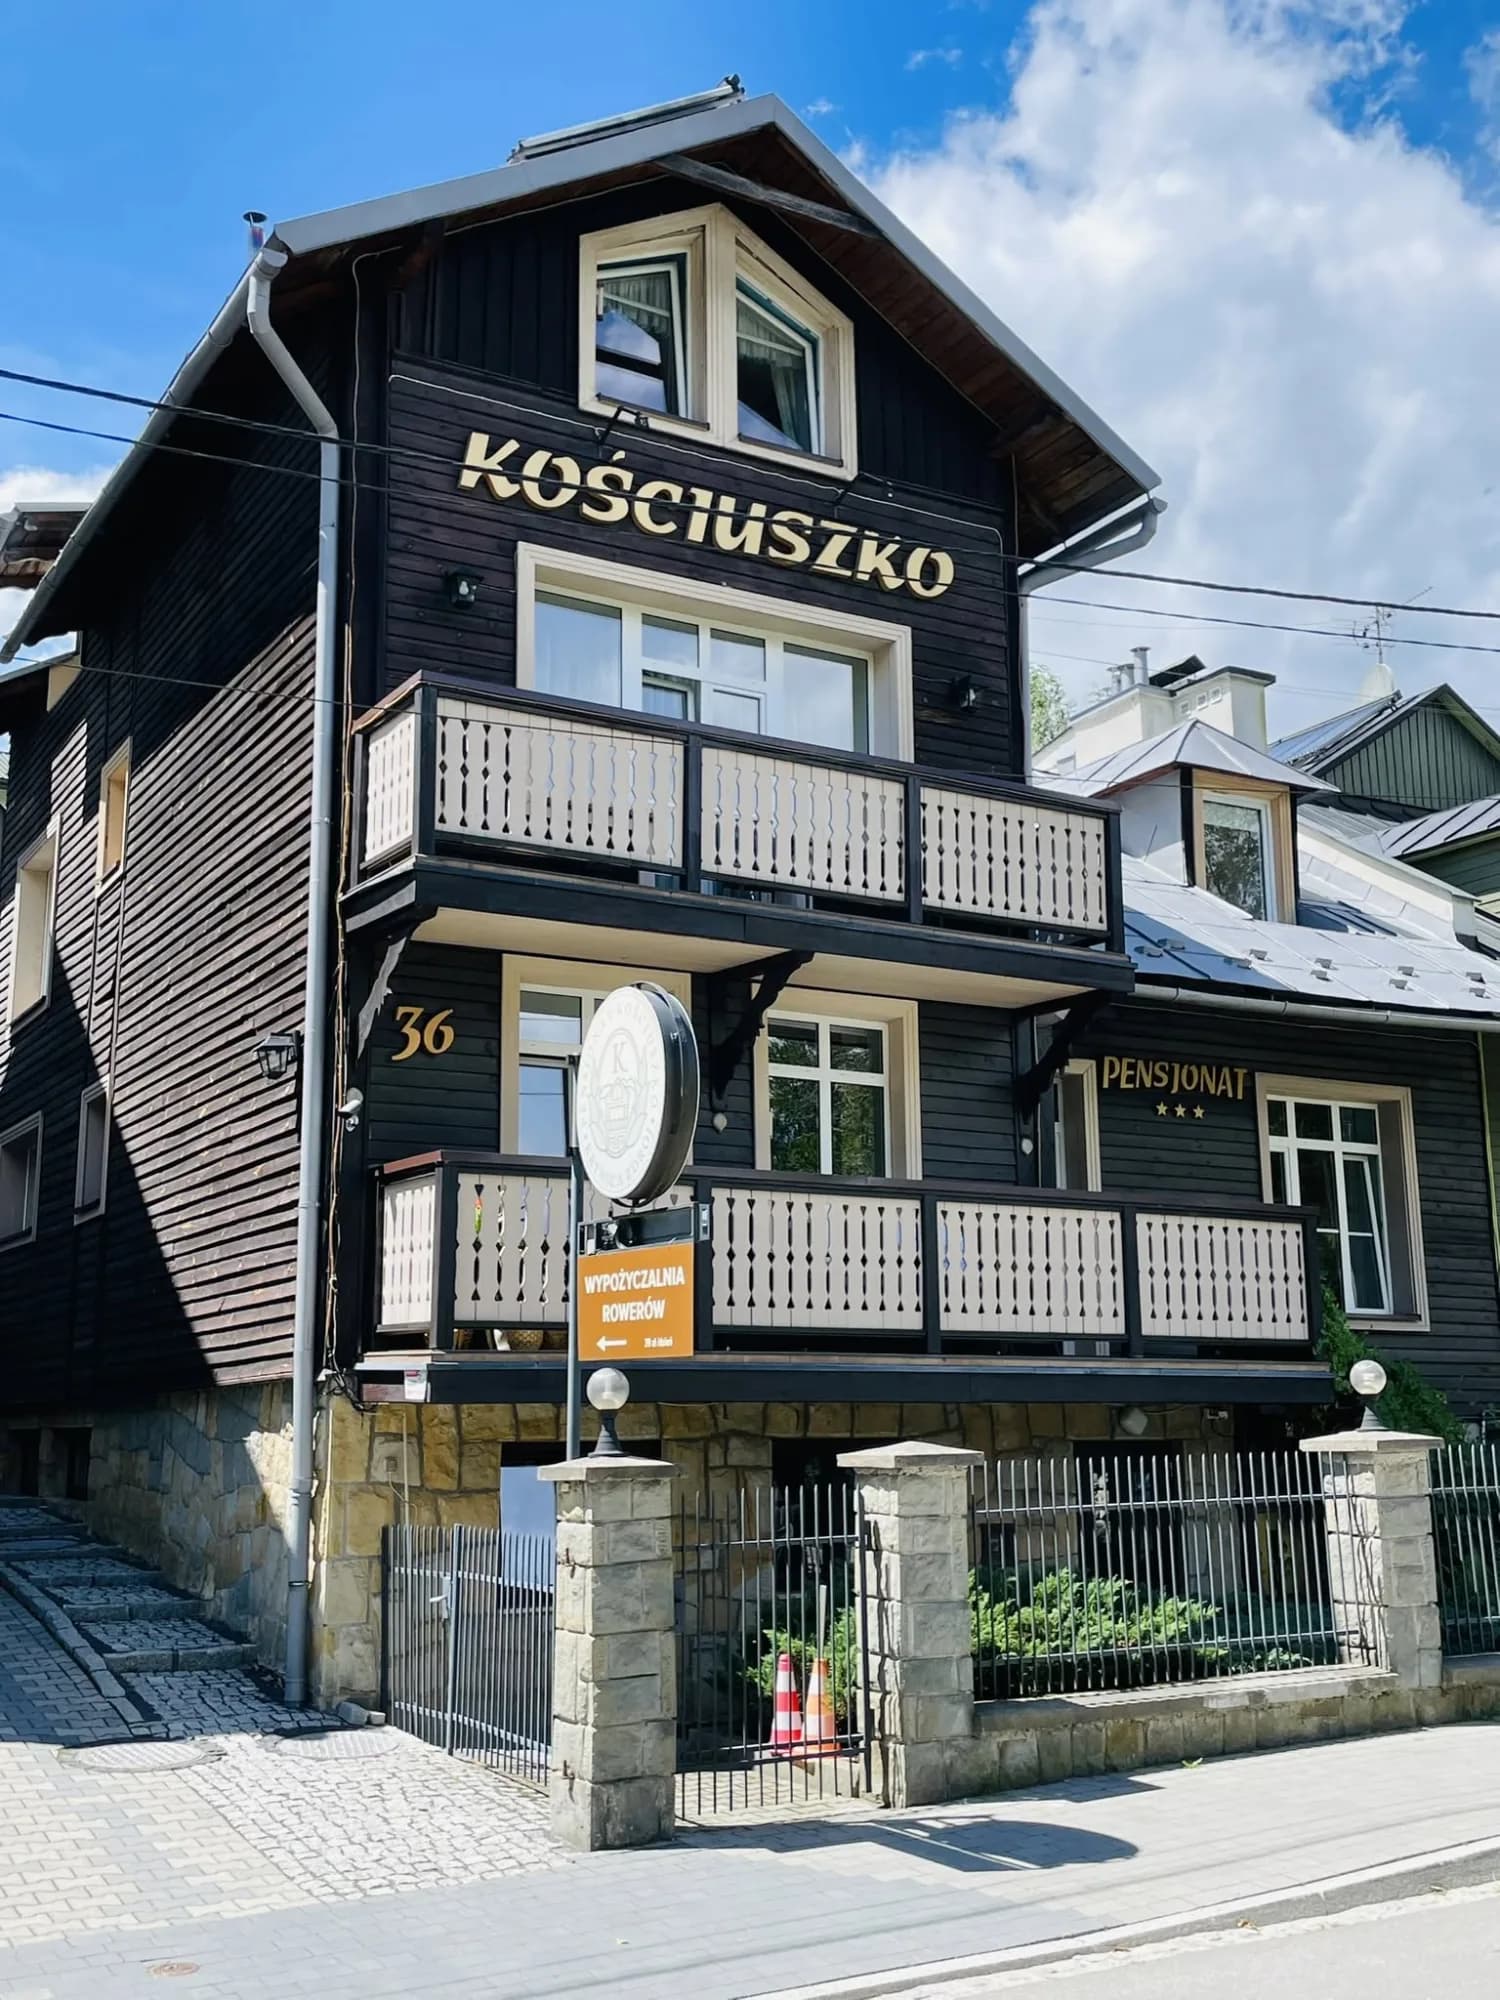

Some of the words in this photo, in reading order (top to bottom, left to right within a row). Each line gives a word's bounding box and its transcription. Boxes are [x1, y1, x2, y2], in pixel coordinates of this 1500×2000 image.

[456, 432, 956, 600] KOŚCIUSZKO
[391, 1006, 455, 1061] 36
[613, 1042, 627, 1073] K
[1102, 1056, 1248, 1100] PENSJONAT
[584, 1265, 686, 1294] WYPOŻYCZALNIA
[602, 1296, 666, 1323] ROWERÓW
